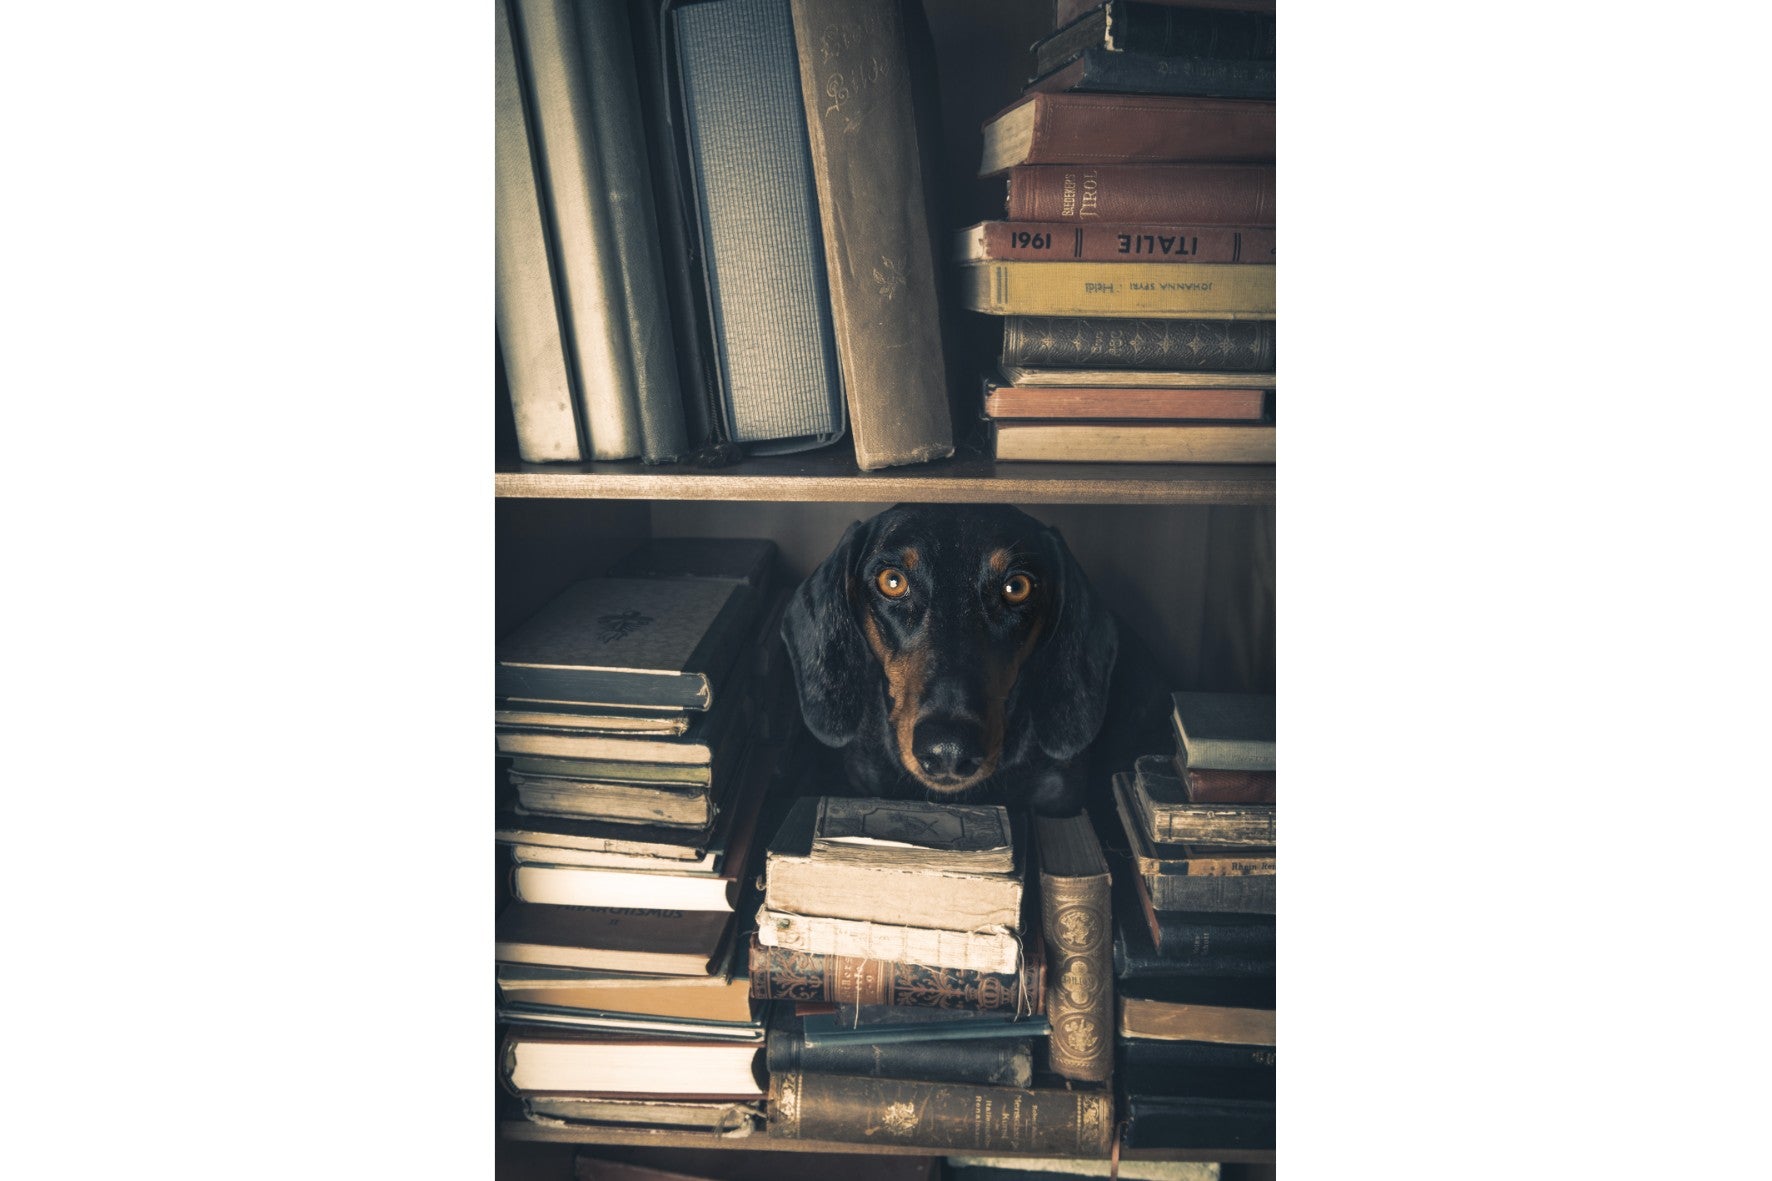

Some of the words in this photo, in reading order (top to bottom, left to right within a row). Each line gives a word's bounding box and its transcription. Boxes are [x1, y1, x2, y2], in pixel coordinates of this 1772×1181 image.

[1079, 169, 1099, 220] TIROL
[1011, 231, 1052, 250] 1961
[1117, 234, 1198, 256] ITALIE
[1085, 281, 1114, 294] Heidi
[1129, 281, 1156, 291] SPYRI
[1159, 281, 1213, 291] JOHANNA
